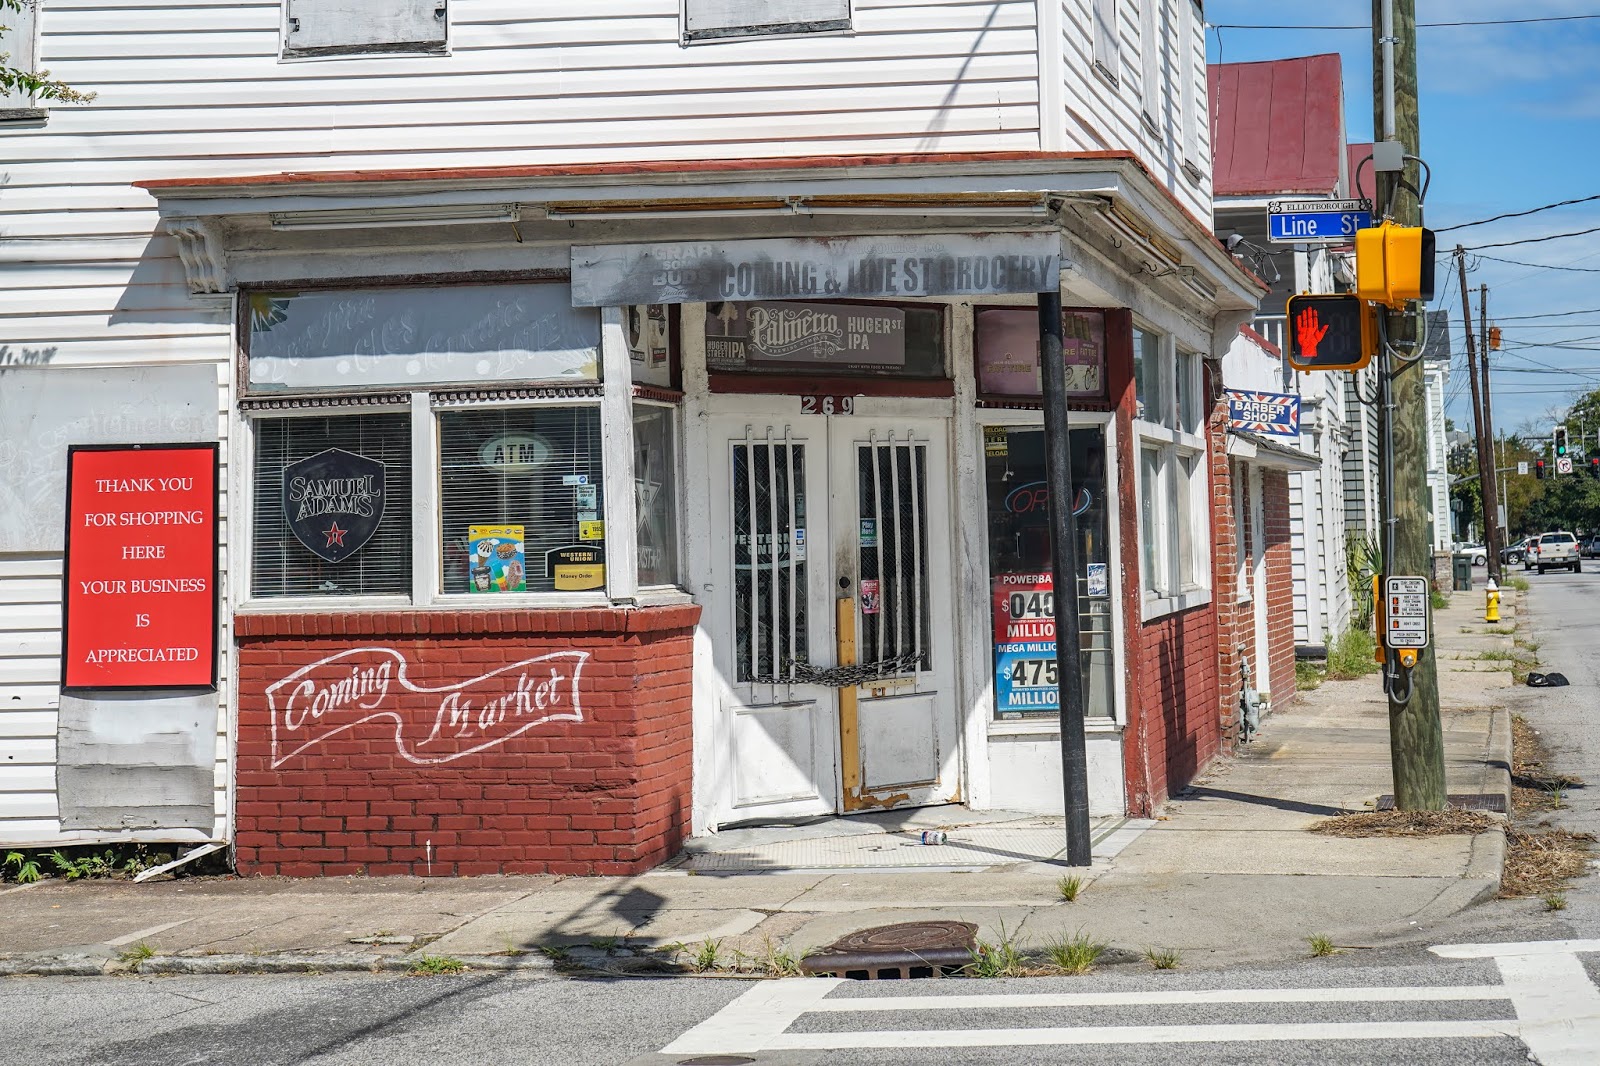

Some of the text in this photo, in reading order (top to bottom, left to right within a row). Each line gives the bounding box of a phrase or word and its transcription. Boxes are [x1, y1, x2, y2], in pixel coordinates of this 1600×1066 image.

[1281, 215, 1361, 236] Line St
[653, 244, 712, 261] GRAB
[719, 261, 817, 297] COMING
[824, 262, 841, 294] &
[903, 256, 932, 292] ST
[938, 254, 1053, 292] GROCERY
[746, 306, 838, 351] Palmetto
[847, 316, 904, 334] HUGER ST.
[728, 341, 746, 359] IPA
[848, 333, 870, 350] IPA
[706, 349, 728, 358] STREET
[1063, 348, 1076, 356] RE
[801, 395, 854, 415] 269
[1234, 401, 1285, 415] BARBER
[1242, 411, 1277, 422] SHOP
[493, 443, 535, 464] ATM
[96, 477, 194, 493] THANK YOU
[289, 474, 381, 502] SAMUEL
[295, 494, 375, 522] ADAMS
[84, 511, 203, 527] FOR SHOPPING
[121, 546, 166, 560] HERE
[80, 578, 206, 595] YOUR BUSINESS
[1003, 574, 1053, 585] POWERBA
[135, 614, 150, 628] IS
[1007, 623, 1055, 638] MILLIO
[85, 647, 199, 664] APPRECIATED
[998, 643, 1057, 653] MEGA MILLIO
[285, 660, 565, 746] Coming Market
[1008, 690, 1060, 706] MILLIO
